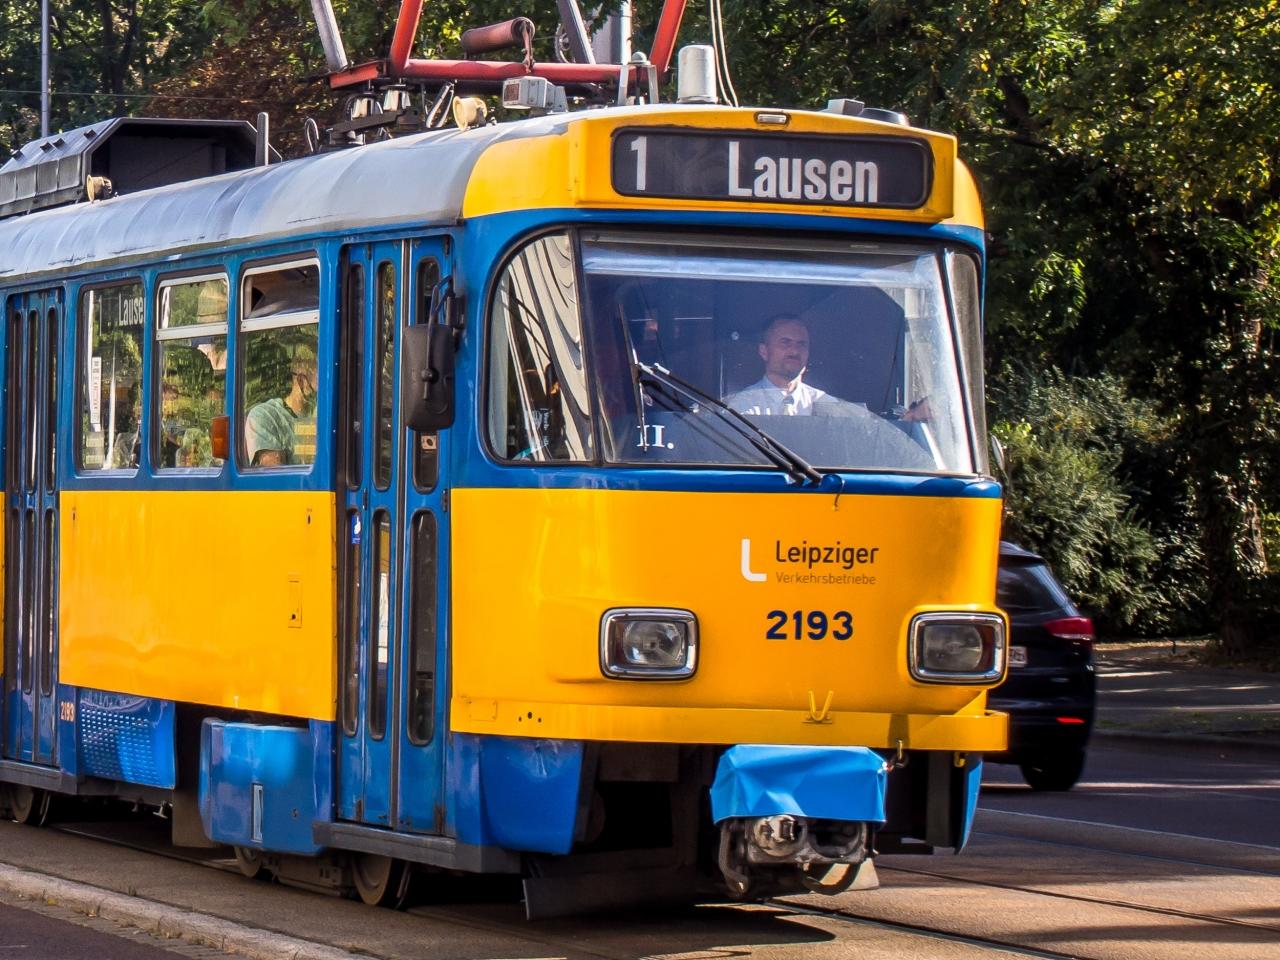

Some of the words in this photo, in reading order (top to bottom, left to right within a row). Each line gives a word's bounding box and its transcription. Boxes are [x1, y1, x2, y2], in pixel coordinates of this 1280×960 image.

[630, 135, 647, 191] 1
[729, 141, 878, 203] Lausen
[776, 540, 879, 570] Leipziger
[775, 572, 877, 585] Verkehrsbetriebe
[766, 609, 853, 641] 2193
